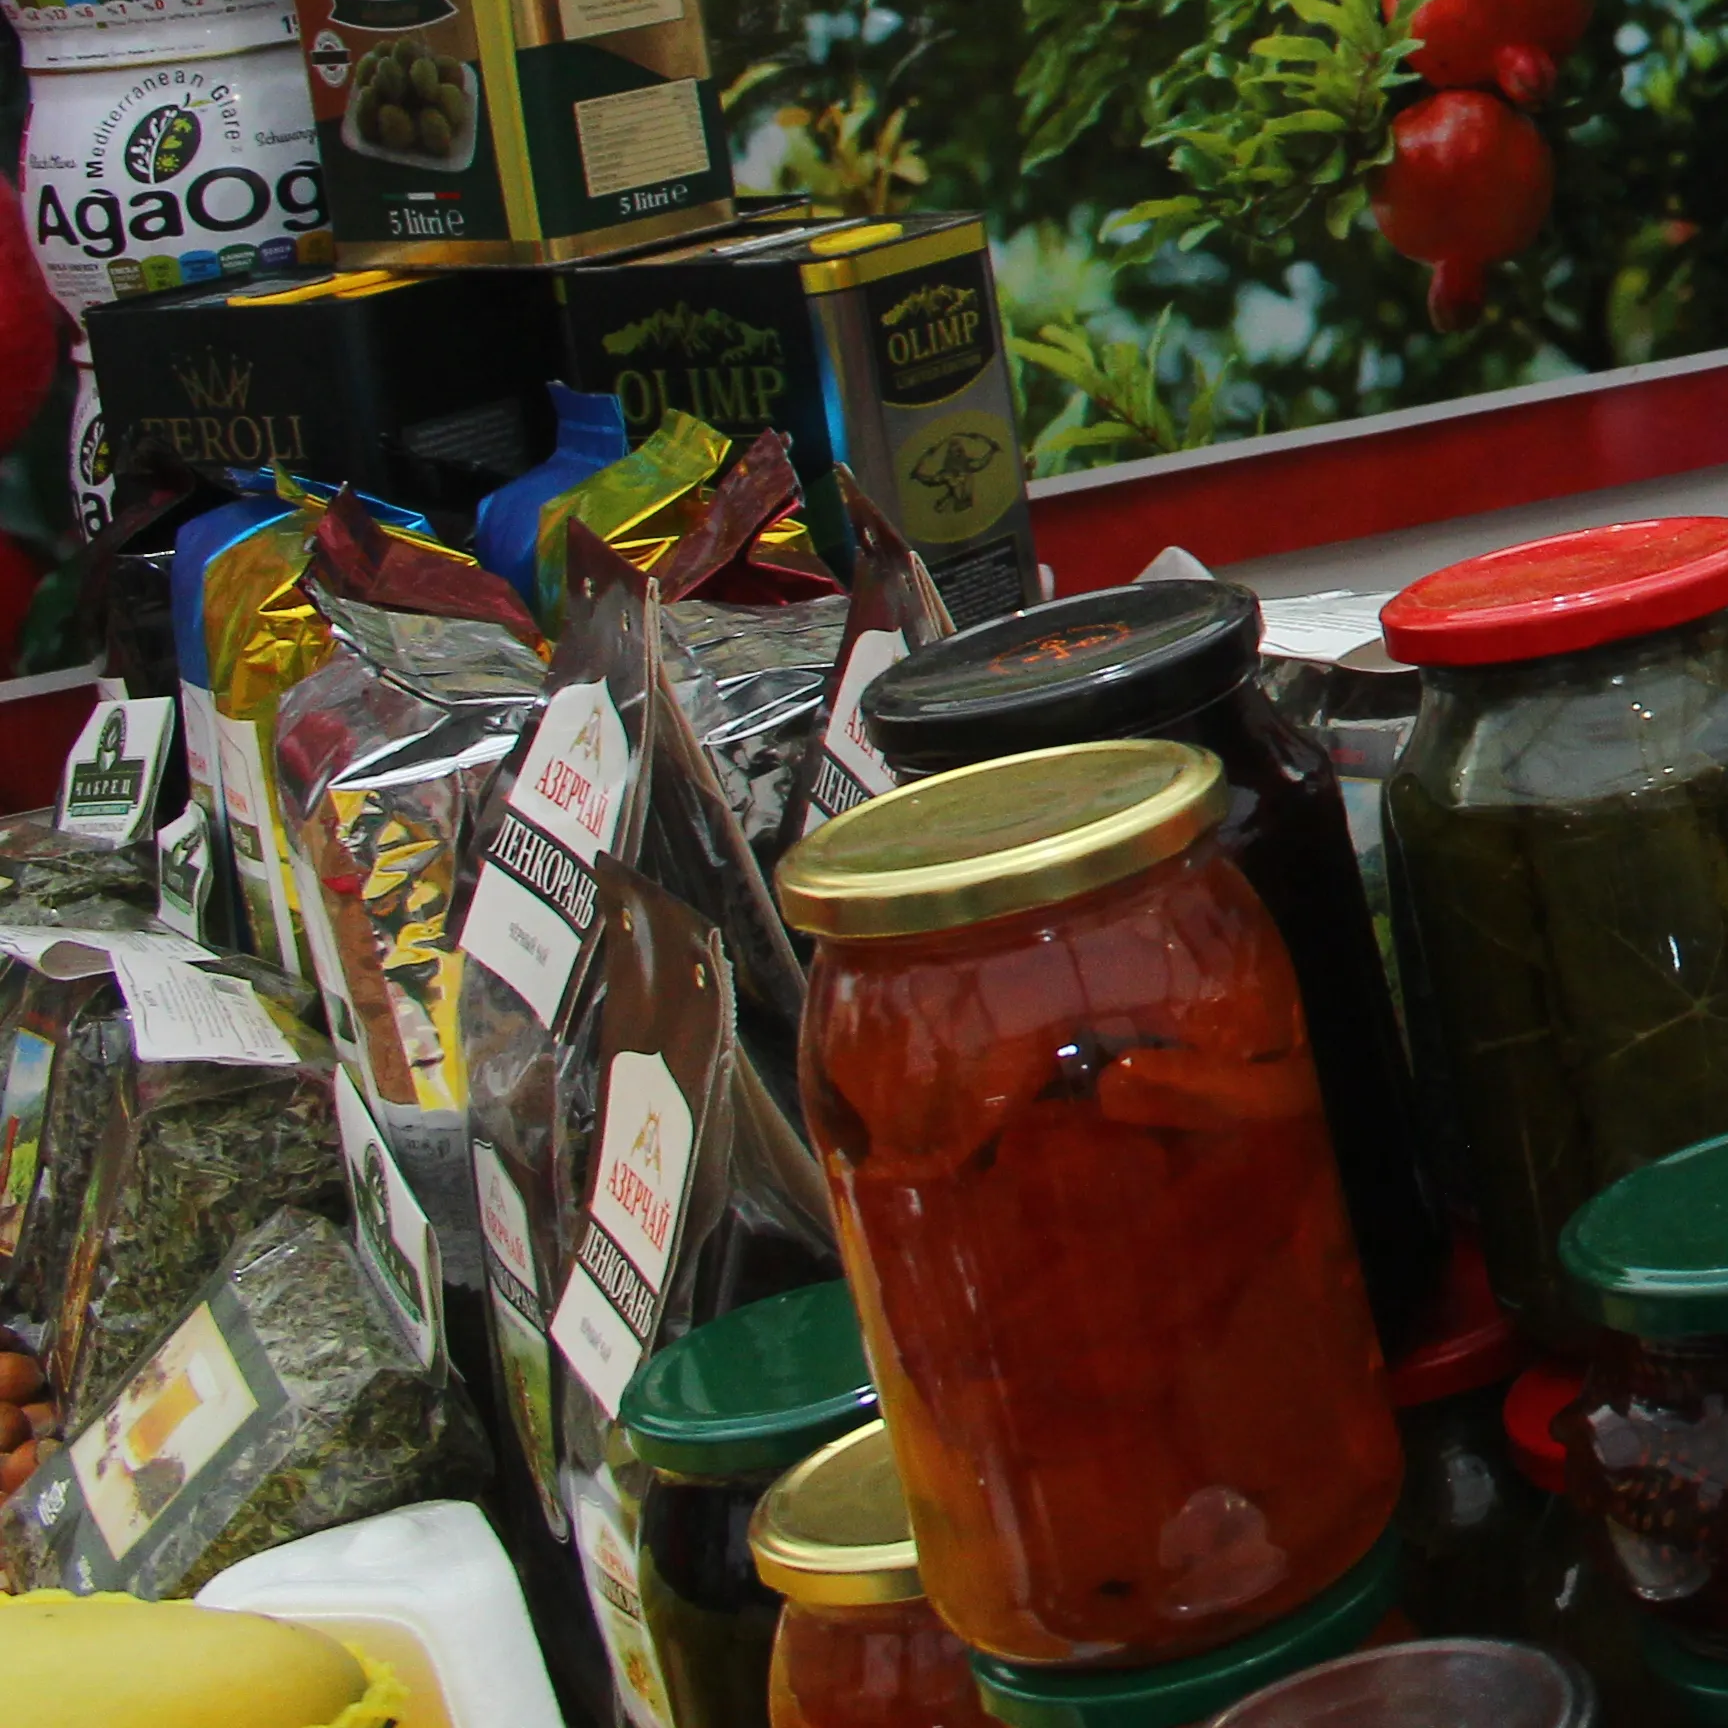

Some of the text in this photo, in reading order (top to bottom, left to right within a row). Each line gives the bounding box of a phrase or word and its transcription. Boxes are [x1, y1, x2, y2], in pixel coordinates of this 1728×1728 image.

[388, 209, 403, 236] 5
[403, 207, 445, 236] litri
[619, 196, 632, 216] 5
[633, 187, 670, 212] litri
[887, 310, 980, 367] OLIMP
[612, 365, 786, 426] OLIMP
[74, 778, 132, 797] ЧАБРЕЦ
[534, 756, 610, 840] АЗЕРЧАЙ
[488, 813, 599, 931] ЛЕНКОРАНЬ
[607, 1157, 673, 1253] АЗЕРЧАЙ
[577, 1220, 656, 1339] ЛЕНКОРАНЬ
